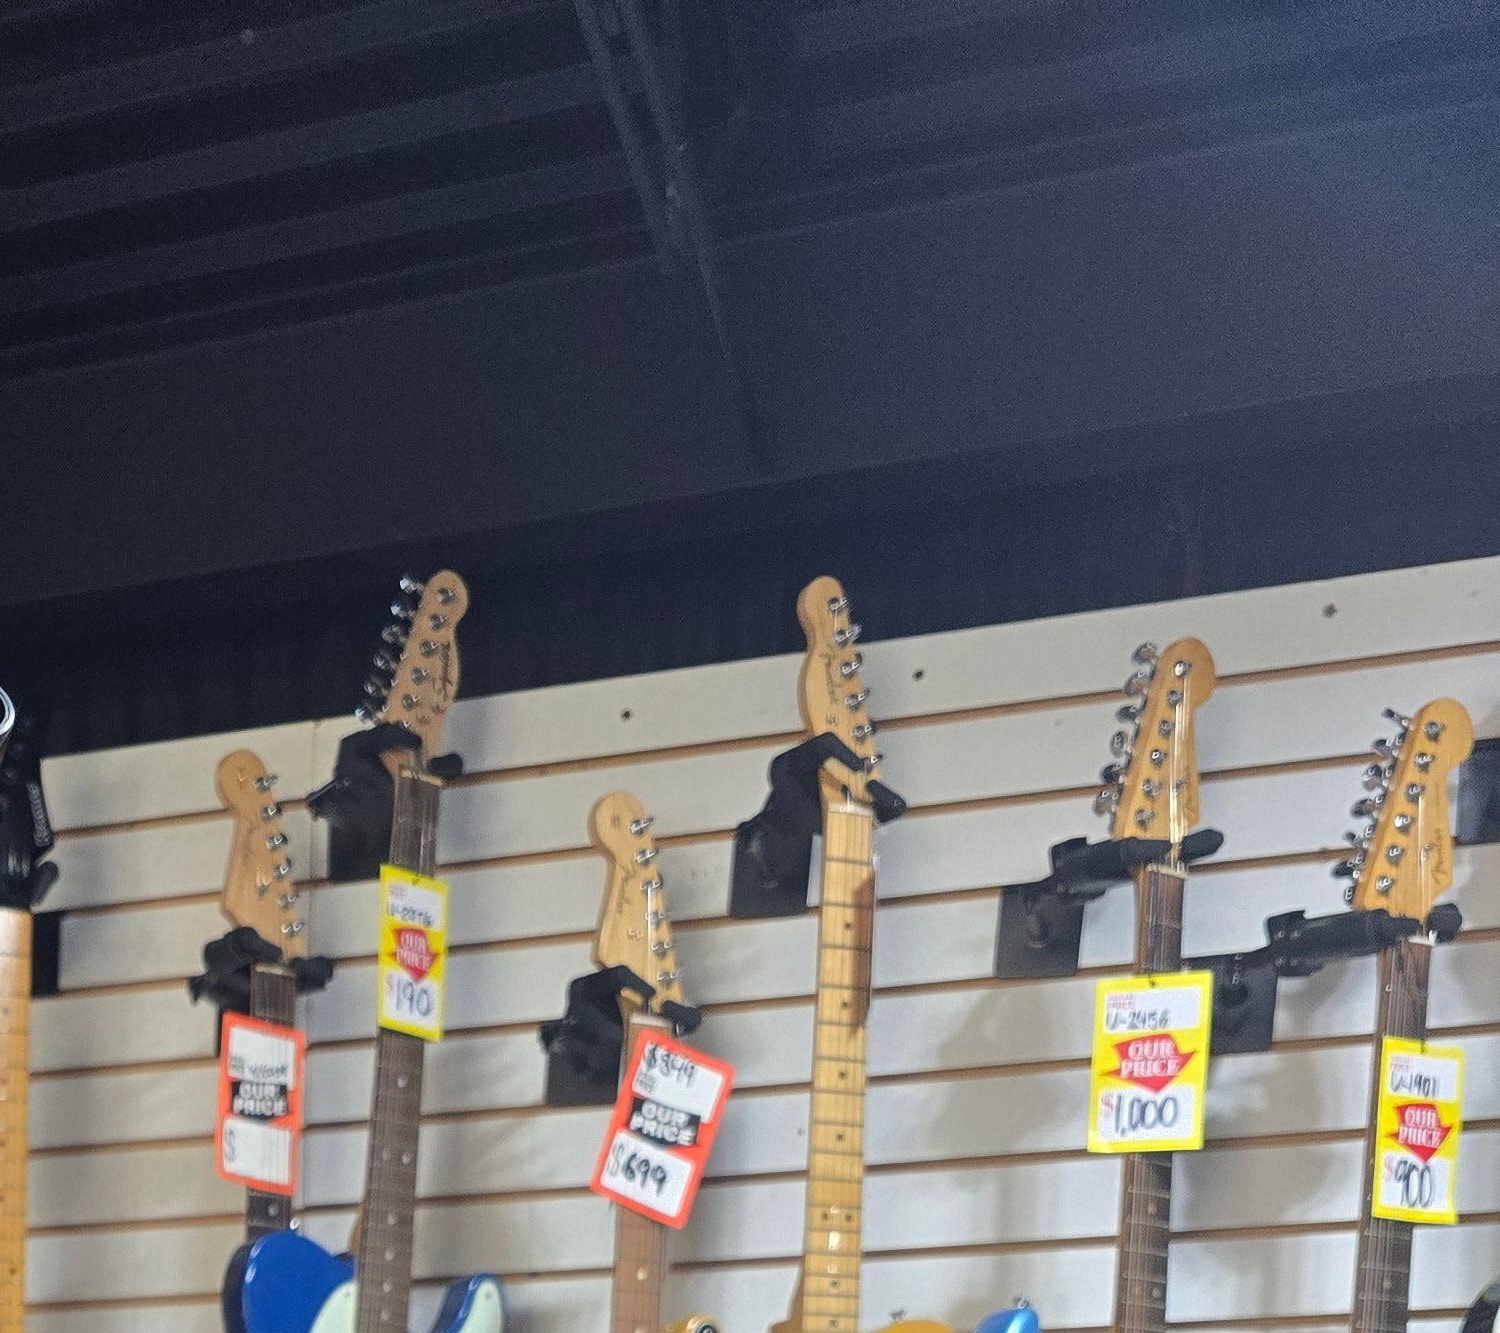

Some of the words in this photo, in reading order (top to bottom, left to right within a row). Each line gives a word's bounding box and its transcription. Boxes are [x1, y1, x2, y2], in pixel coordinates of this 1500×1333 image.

[1128, 1040, 1176, 1060] OUR
[1120, 1058, 1180, 1079] PRICE
[239, 1081, 280, 1100] OUR
[233, 1095, 287, 1117] PRICE
[641, 1100, 691, 1128] OUR
[1404, 1106, 1437, 1128] OUR
[629, 1111, 697, 1147] PRICE
[1398, 1124, 1443, 1149] PRICE
[607, 1142, 667, 1197] $699
